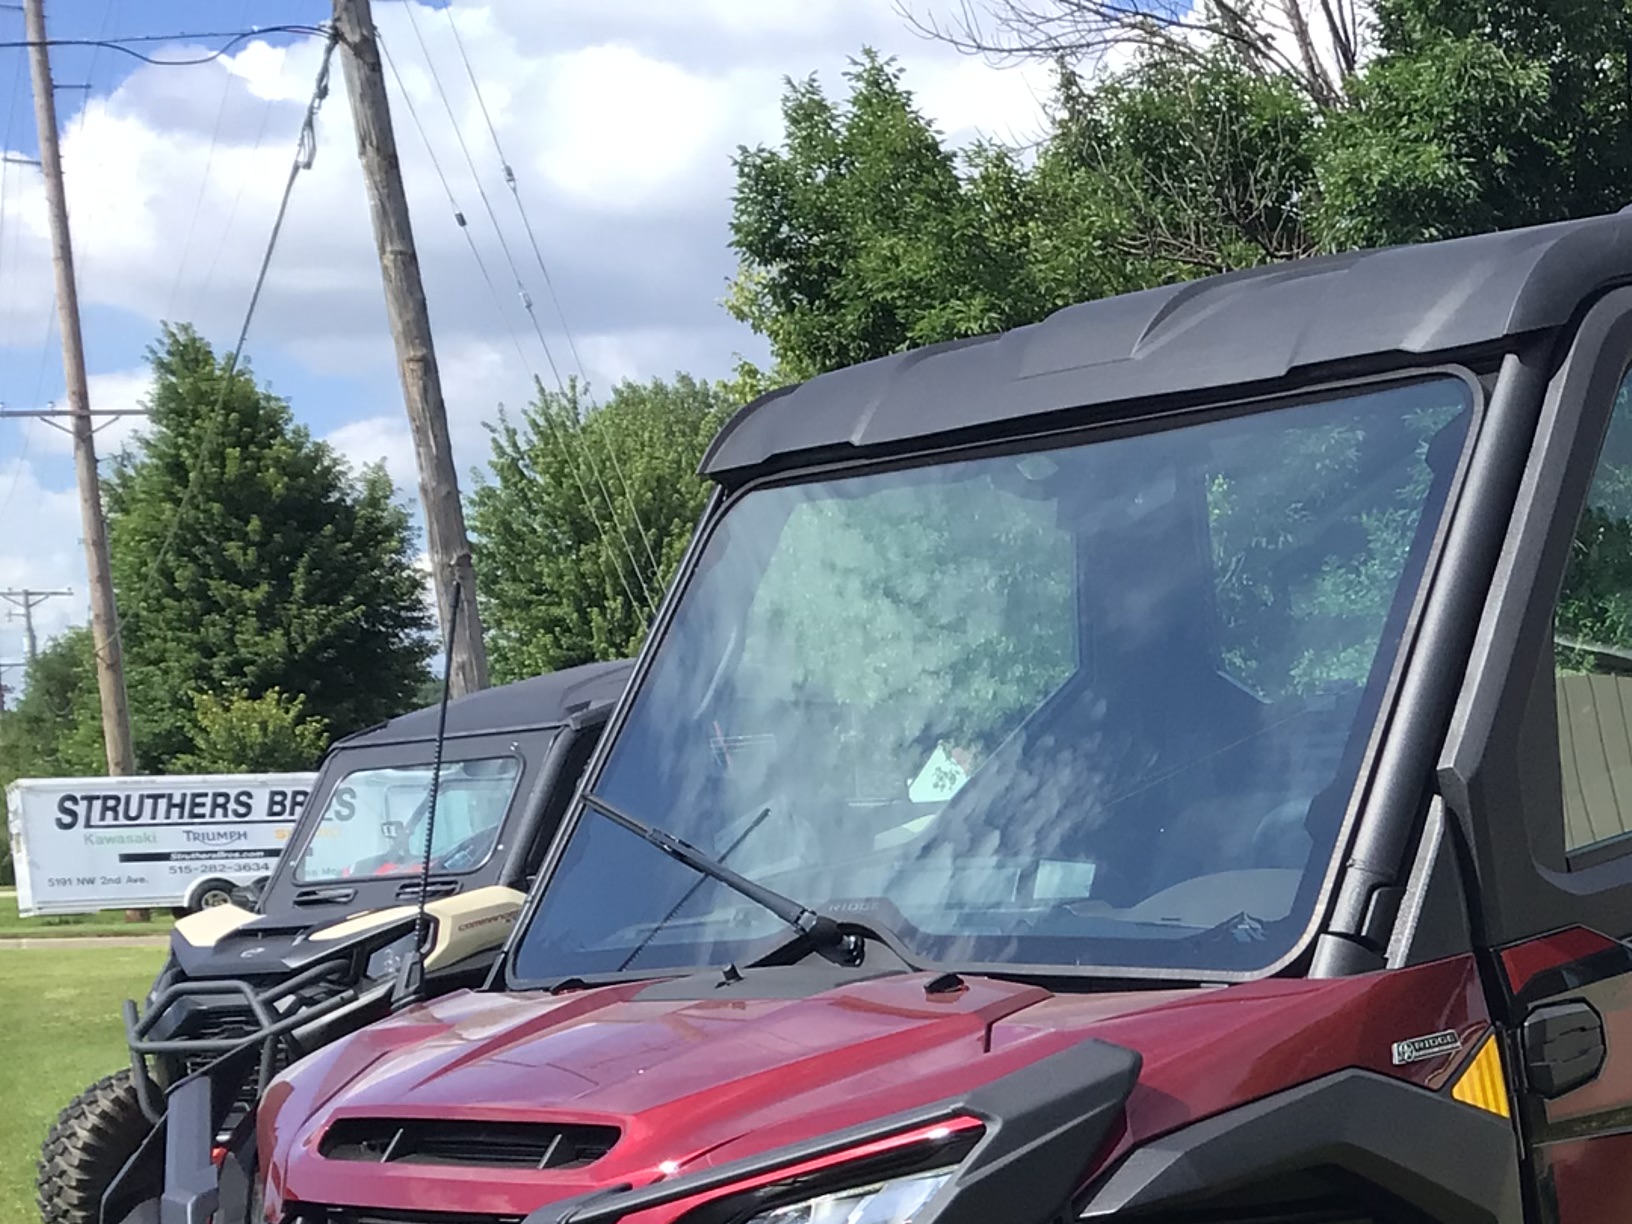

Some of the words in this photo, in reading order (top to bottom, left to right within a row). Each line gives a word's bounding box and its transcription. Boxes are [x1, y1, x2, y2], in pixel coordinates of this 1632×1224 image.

[55, 790, 253, 830] STRUTHERS
[266, 787, 357, 822] BRS
[83, 832, 157, 845] Kawasaki
[182, 830, 247, 846] TRIUMPH
[168, 863, 270, 874] 515-282-3634
[48, 878, 72, 887] 5191
[76, 877, 96, 886] NW
[100, 876, 121, 885] 2nd
[126, 875, 148, 885] Ave.
[1414, 1034, 1456, 1050] RIDGE
